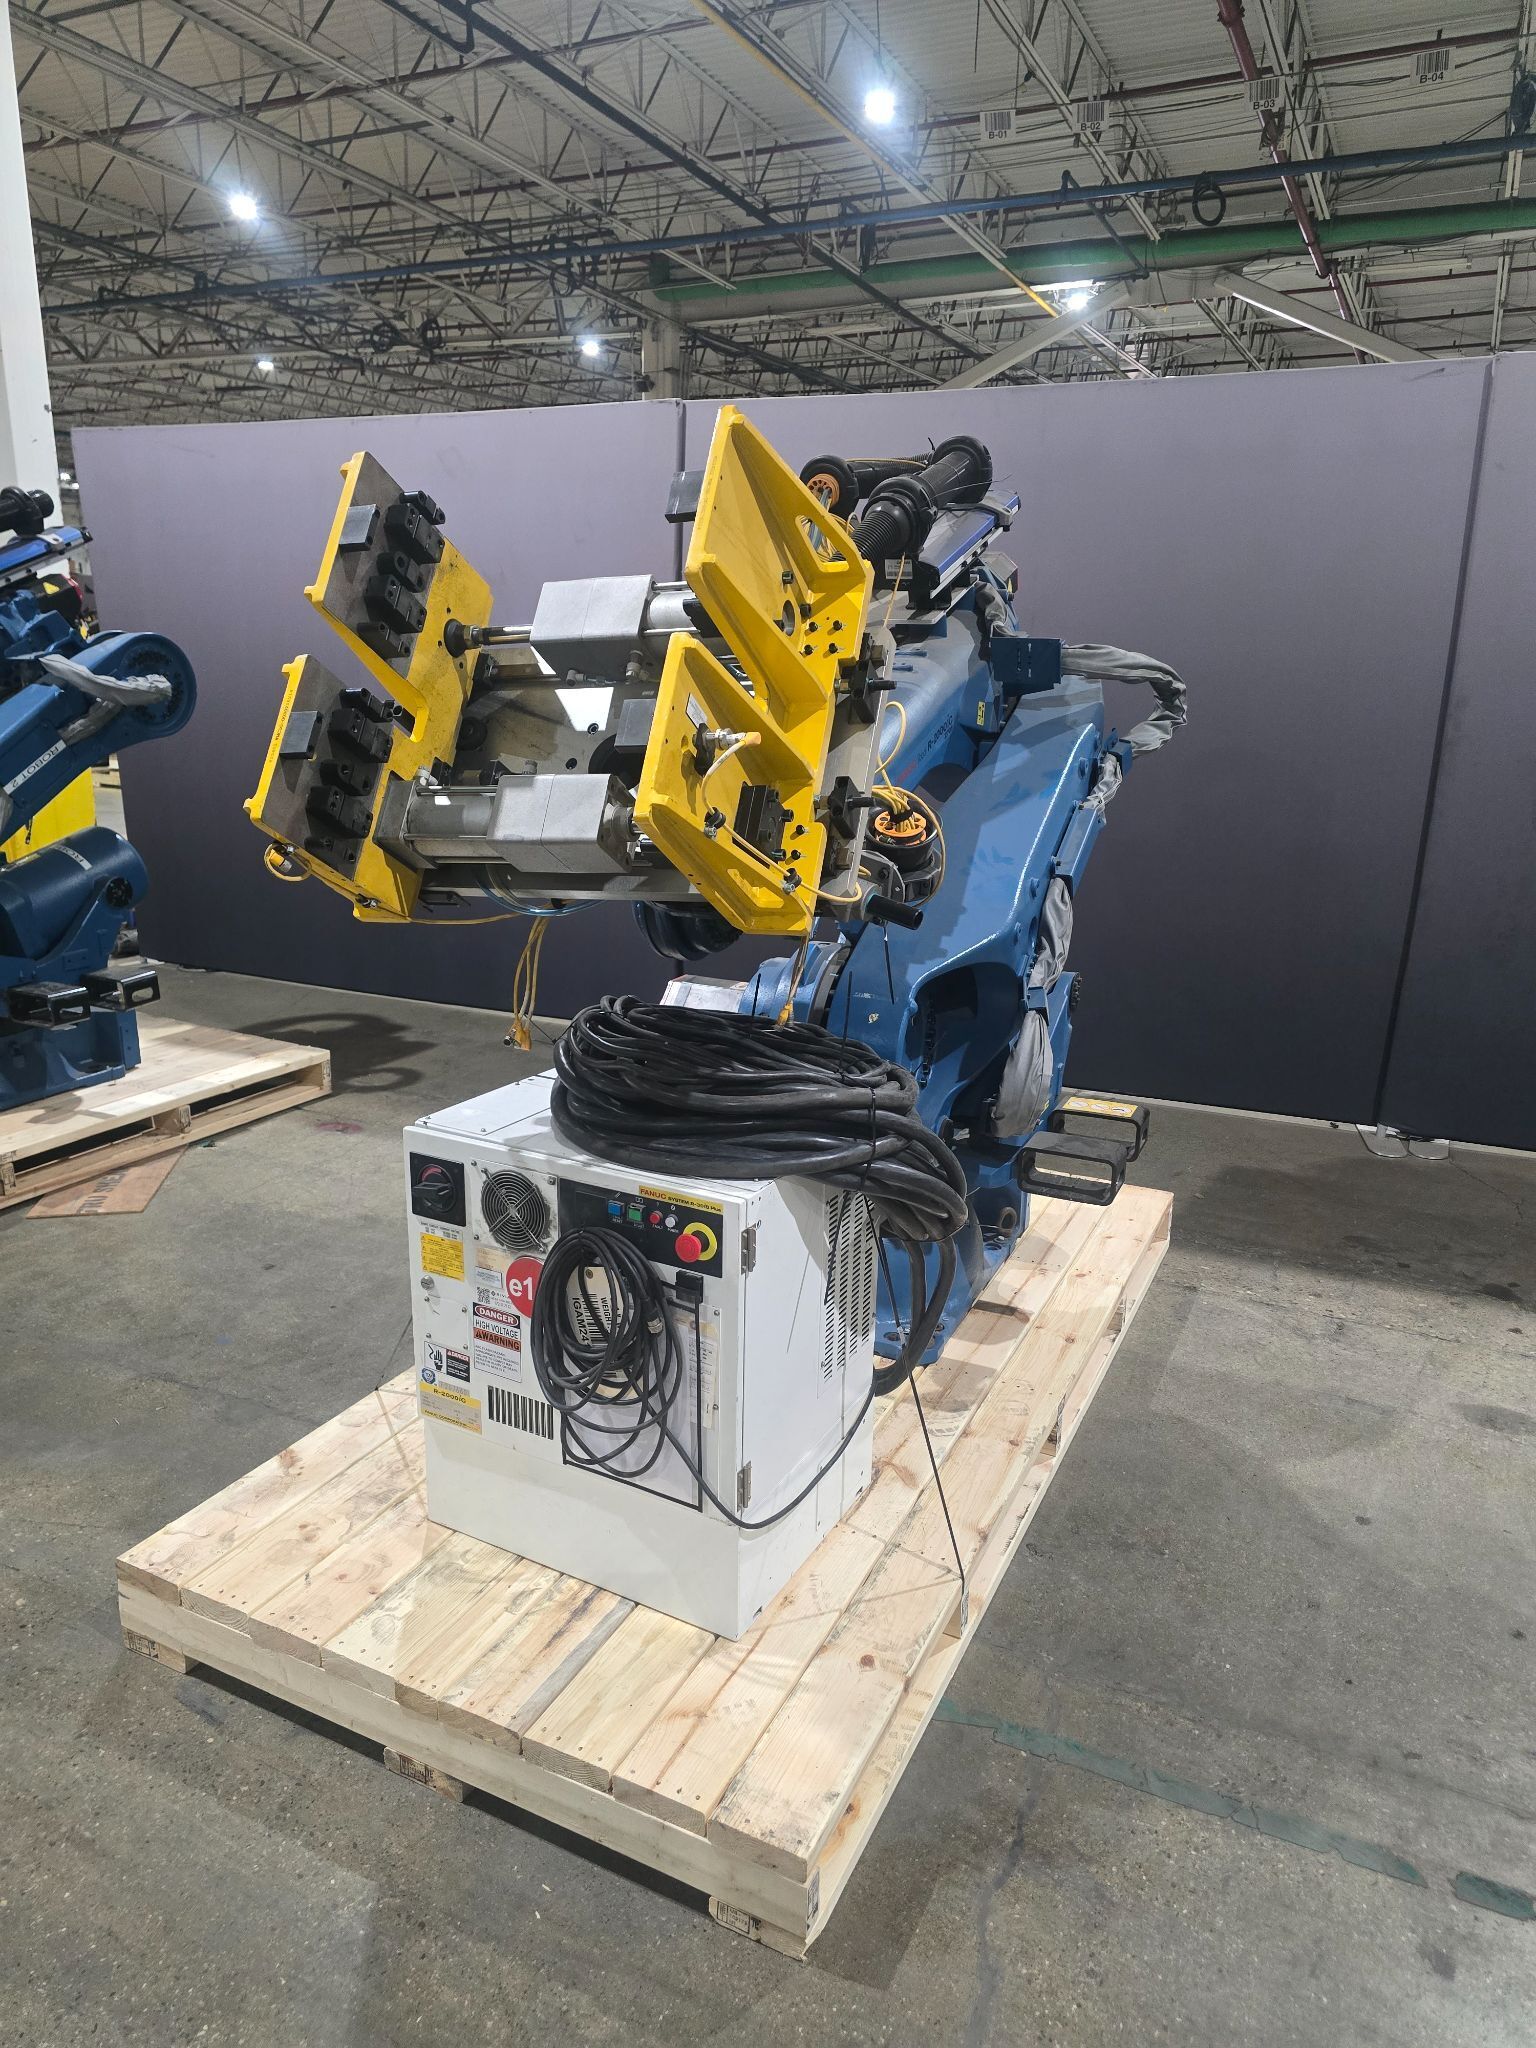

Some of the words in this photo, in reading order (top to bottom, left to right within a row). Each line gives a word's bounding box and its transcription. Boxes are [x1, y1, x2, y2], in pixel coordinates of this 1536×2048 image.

[1419, 71, 1444, 83] B-04
[1253, 101, 1275, 110] B-03
[988, 130, 1007, 139] B-01
[1080, 122, 1101, 131] B-02
[21, 746, 59, 779] ROBOT
[640, 1188, 667, 1200] FANUC
[667, 1196, 689, 1205] SYSTEM
[479, 1307, 514, 1324] DANGER
[572, 1297, 592, 1346] IGAM24
[475, 1319, 490, 1330] HIGH
[491, 1324, 518, 1339] VOLTAGE
[481, 1331, 519, 1350] WARNING
